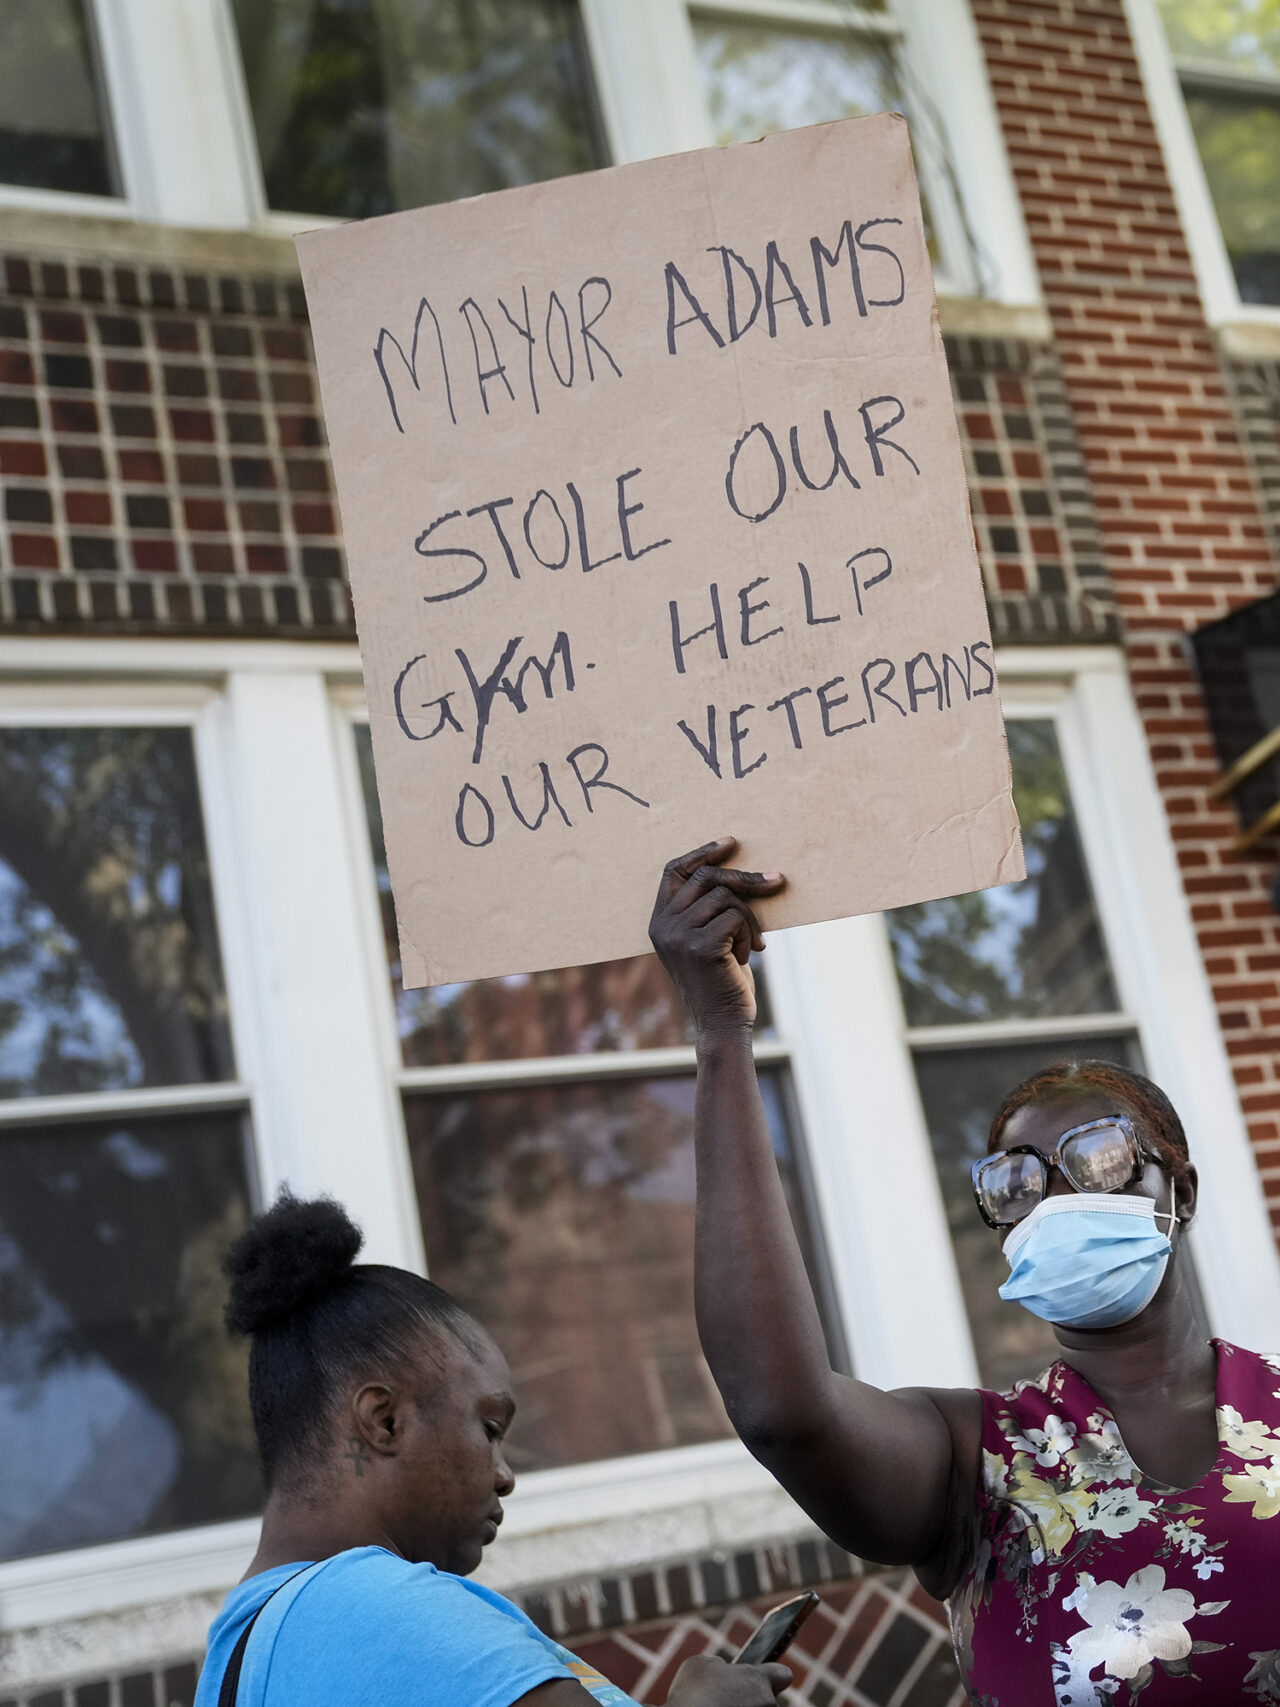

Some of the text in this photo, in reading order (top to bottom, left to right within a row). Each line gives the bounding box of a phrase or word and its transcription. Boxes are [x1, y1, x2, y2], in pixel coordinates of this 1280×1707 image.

[373, 217, 905, 434] MAYOR ADAMS
[414, 395, 921, 604] STOLE OUR
[668, 547, 893, 674] HELP
[455, 641, 995, 848] OUR VETERANS
